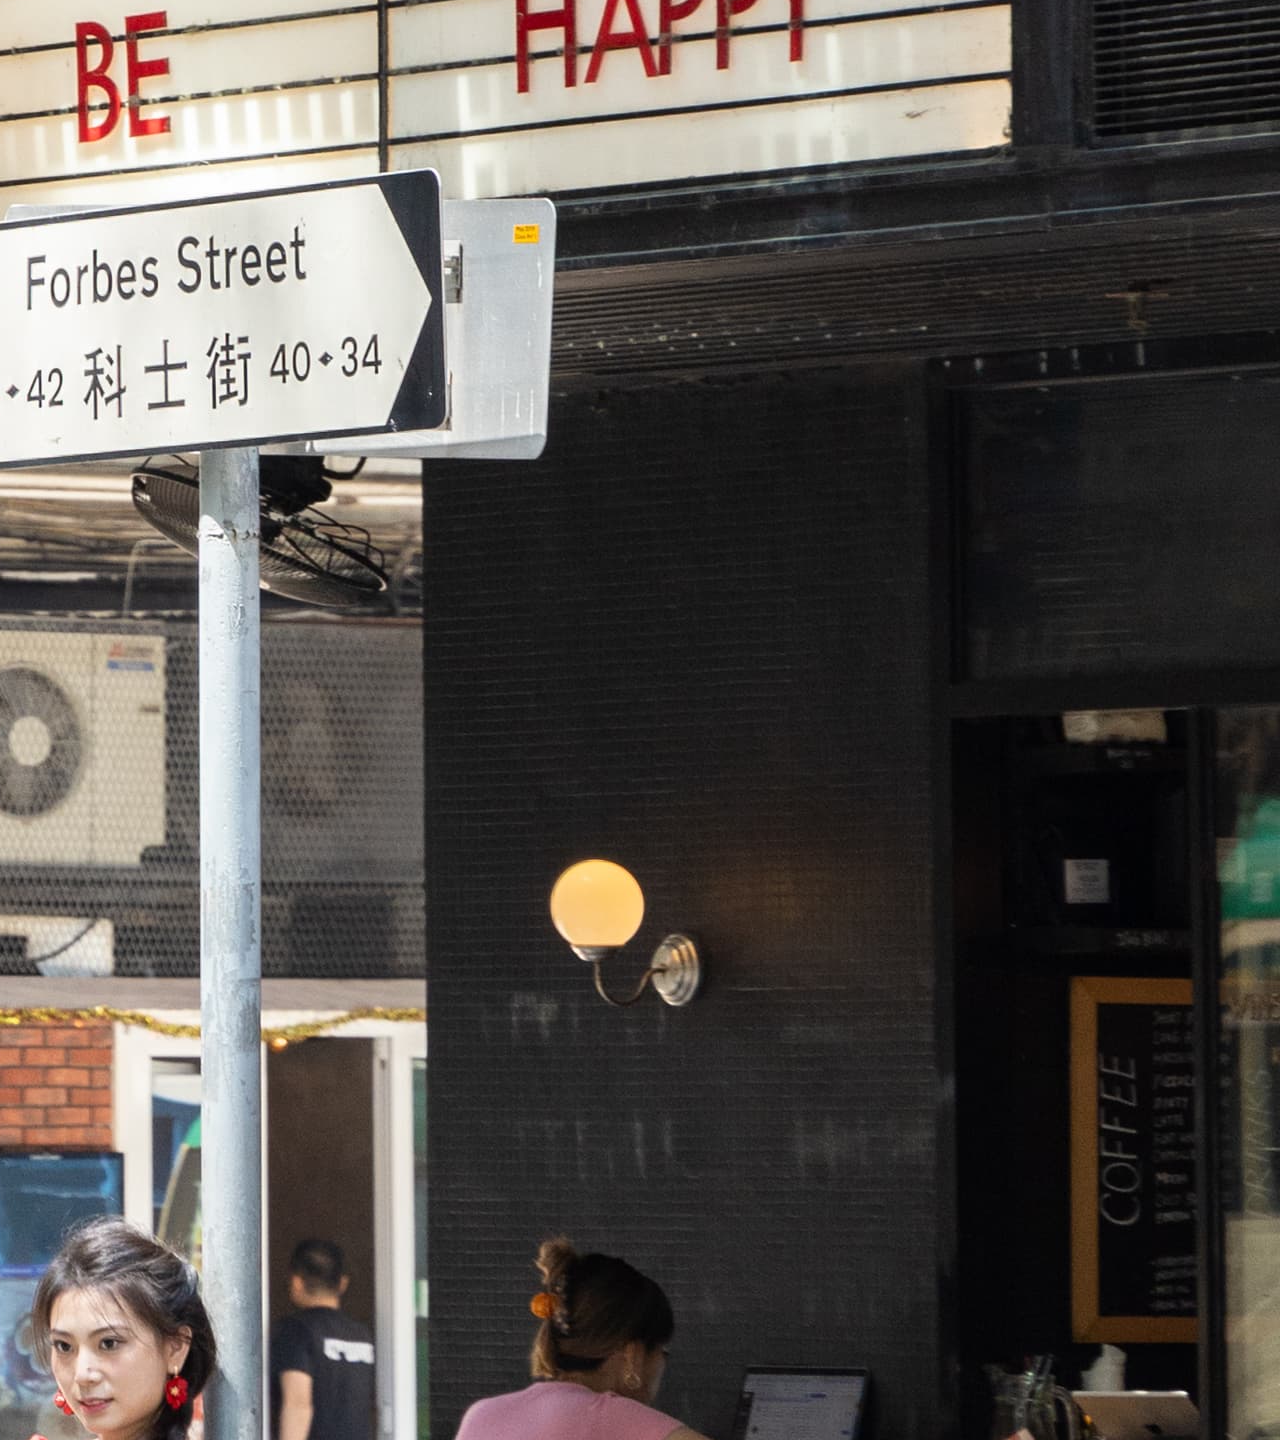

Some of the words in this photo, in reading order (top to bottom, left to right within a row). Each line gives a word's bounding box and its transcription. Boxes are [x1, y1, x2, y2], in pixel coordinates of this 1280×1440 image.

[75, 10, 172, 144] BE
[25, 247, 160, 311] Forbes
[176, 224, 308, 295] Street
[82, 332, 252, 421] 科士街
[1100, 1053, 1140, 1227] COFFEE
